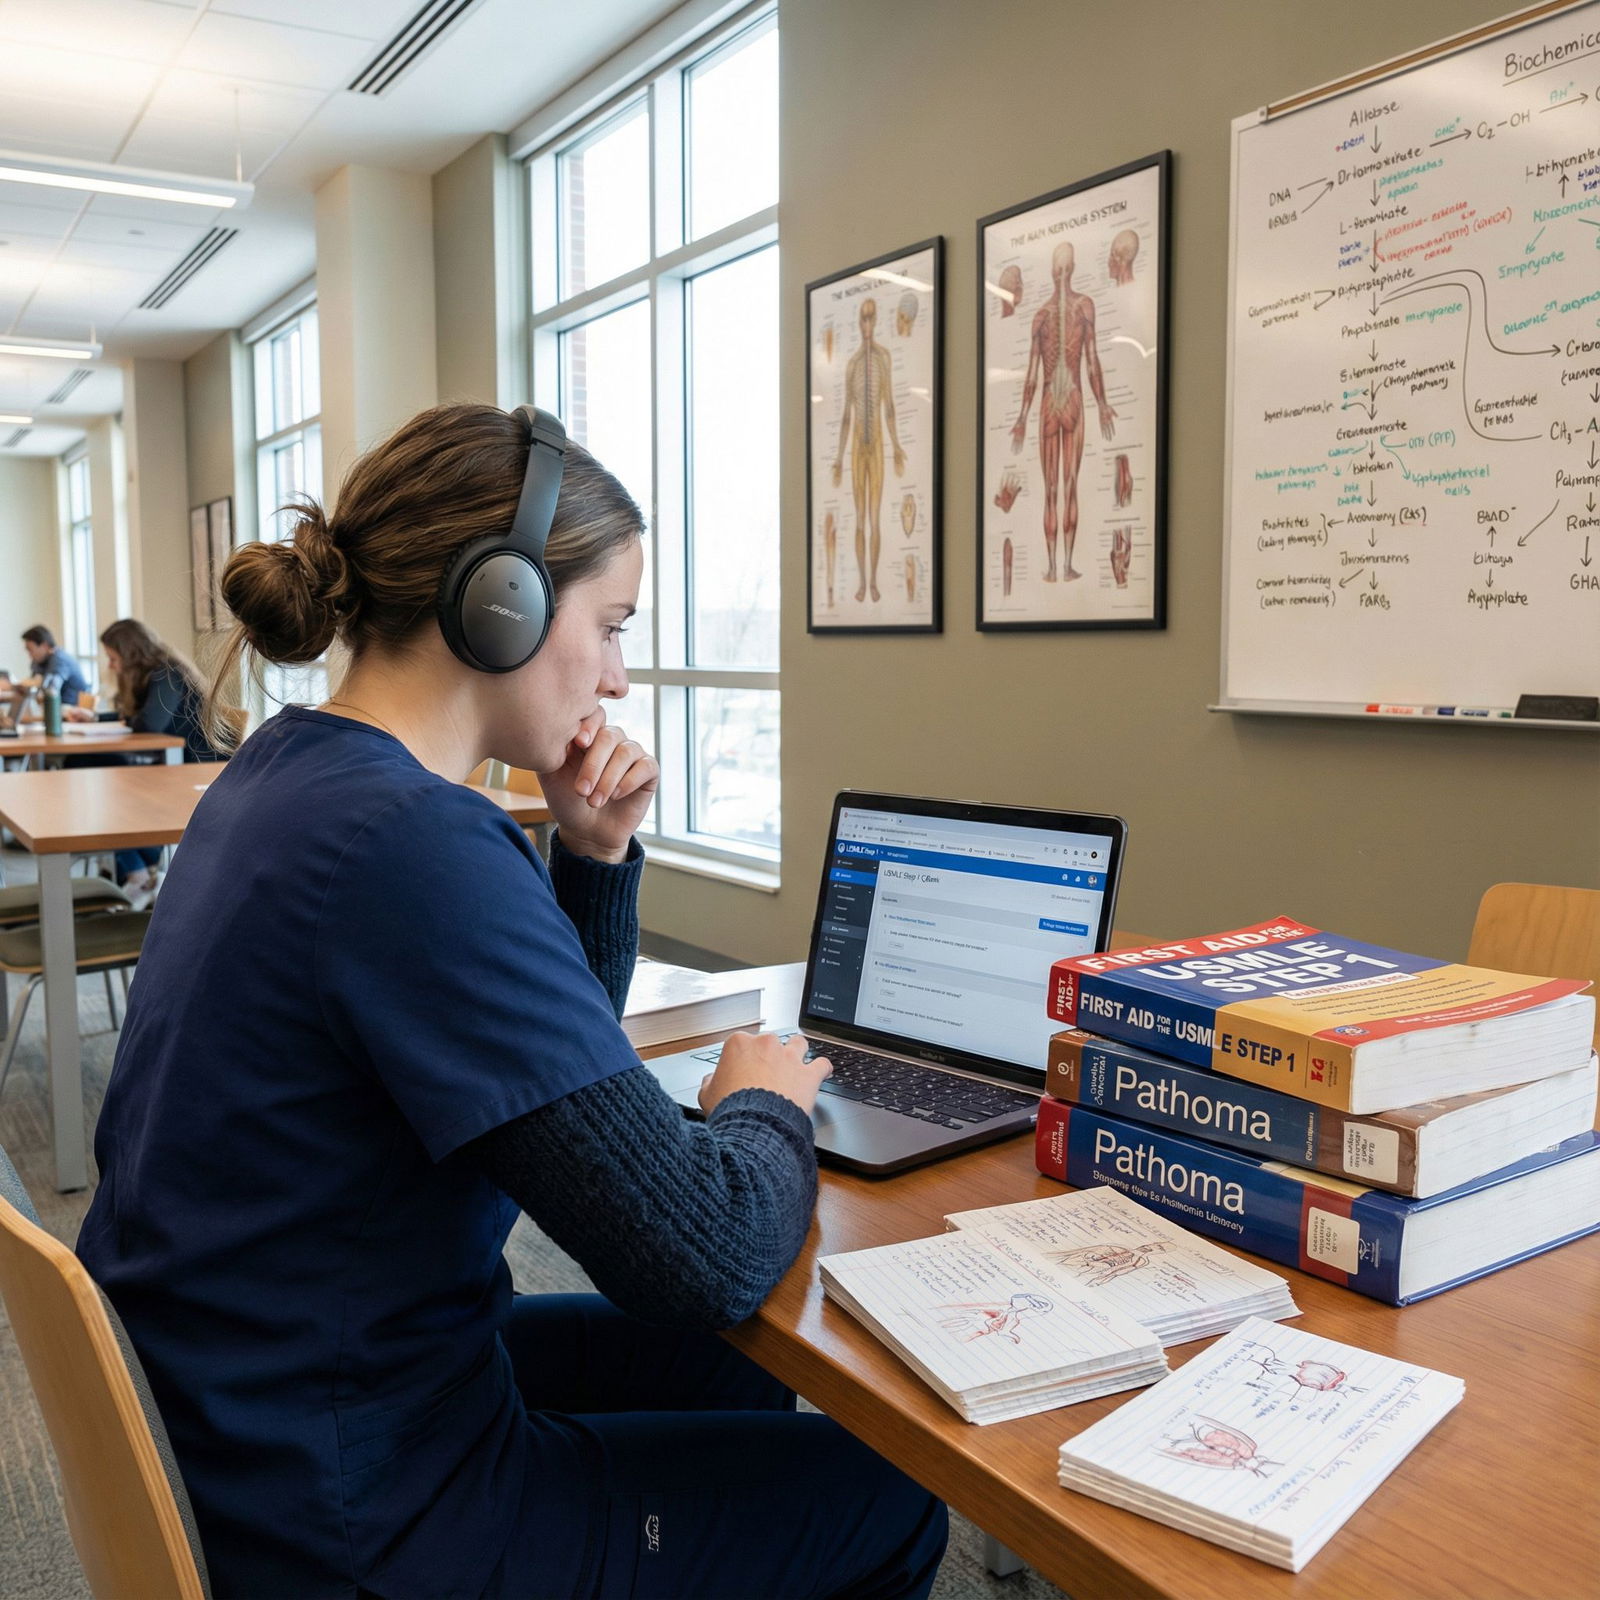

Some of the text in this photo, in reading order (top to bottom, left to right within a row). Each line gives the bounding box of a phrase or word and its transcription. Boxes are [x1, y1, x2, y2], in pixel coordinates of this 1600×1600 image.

[1269, 187, 1292, 207] DNA
[482, 604, 530, 622] BOSE
[1076, 933, 1261, 970] FIRST AID
[1137, 941, 1347, 980] USMLE
[1202, 953, 1400, 993] STEP 1
[1057, 976, 1067, 1016] FIRST
[1064, 986, 1074, 1011] AID
[1080, 992, 1155, 1030] FIRST AID
[1156, 1014, 1171, 1026] FOR
[1156, 1024, 1171, 1036] THE
[1175, 1019, 1296, 1073] USMLE STEP 1
[1114, 1065, 1272, 1143] Pathoma
[1094, 1127, 1245, 1215] Pathoma
